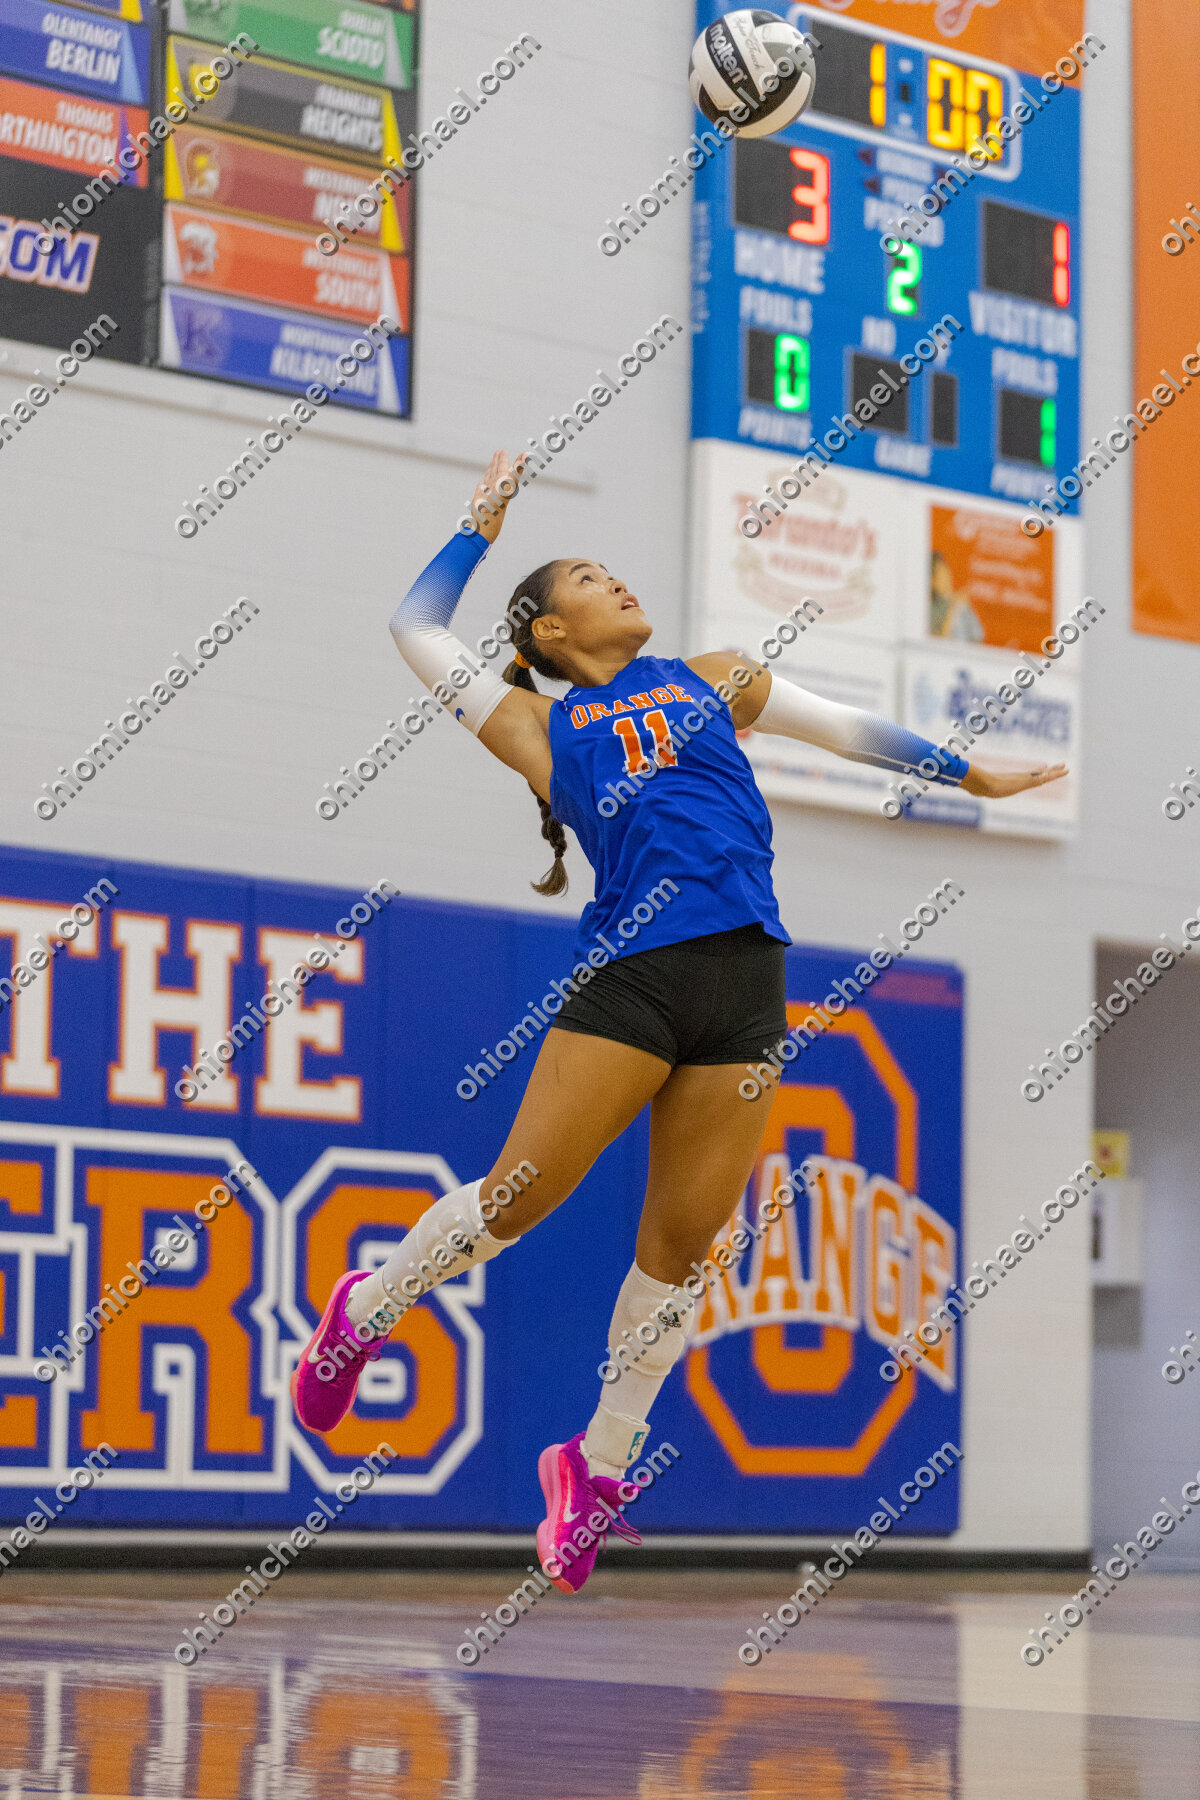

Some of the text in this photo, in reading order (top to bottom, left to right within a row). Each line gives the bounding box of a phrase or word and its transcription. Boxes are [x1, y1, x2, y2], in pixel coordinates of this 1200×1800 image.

[42, 12, 121, 50] OLENTANGY
[46, 38, 121, 84] BERLIN
[317, 26, 386, 69] SCIOTO
[709, 23, 748, 85] molten
[0, 112, 117, 166] RTHINGTON
[57, 101, 114, 134] THOMAS
[785, 147, 831, 245] 3
[886, 238, 923, 316] 2
[1052, 221, 1070, 308] 1
[774, 333, 811, 413] 0
[1039, 398, 1057, 467] 1
[570, 684, 694, 730] ORANGE
[612, 709, 678, 778] 11
[0, 897, 365, 1122] THE
[688, 1152, 957, 1393] RANGE
